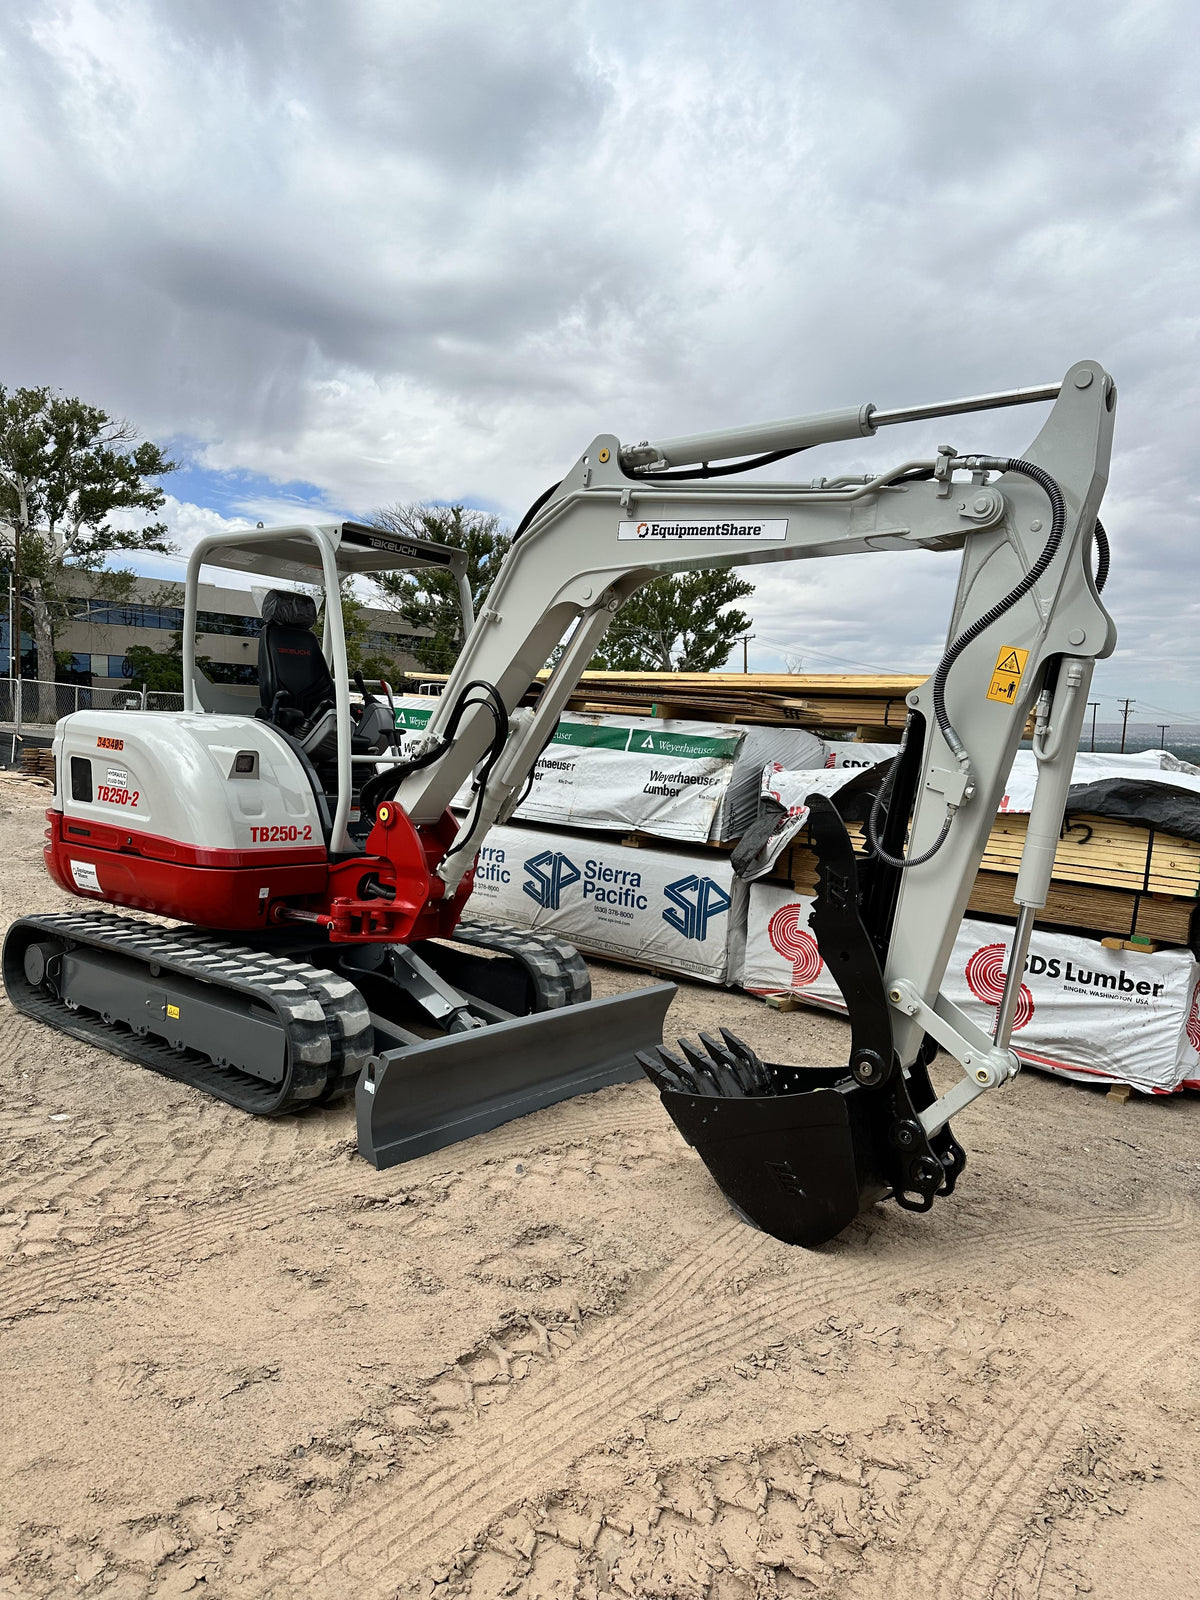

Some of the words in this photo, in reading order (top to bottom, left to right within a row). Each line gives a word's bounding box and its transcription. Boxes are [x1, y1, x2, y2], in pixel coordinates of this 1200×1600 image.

[651, 523, 761, 538] EquipmentShare
[97, 736, 124, 750] 343405
[659, 740, 715, 754] Weyerhaeuser
[649, 769, 721, 787] Weyerhaeuser
[98, 785, 140, 807] TB250-2
[643, 782, 682, 797] Lumber
[250, 825, 313, 843] TB250-2
[476, 862, 511, 883] cific
[583, 859, 642, 888] Sierra
[583, 880, 648, 910] Pacific
[1065, 962, 1164, 997] Lumber
[1063, 985, 1088, 996] BINGEN,
[1089, 990, 1133, 1003] WASHINGTON
[1135, 998, 1149, 1006] USA
